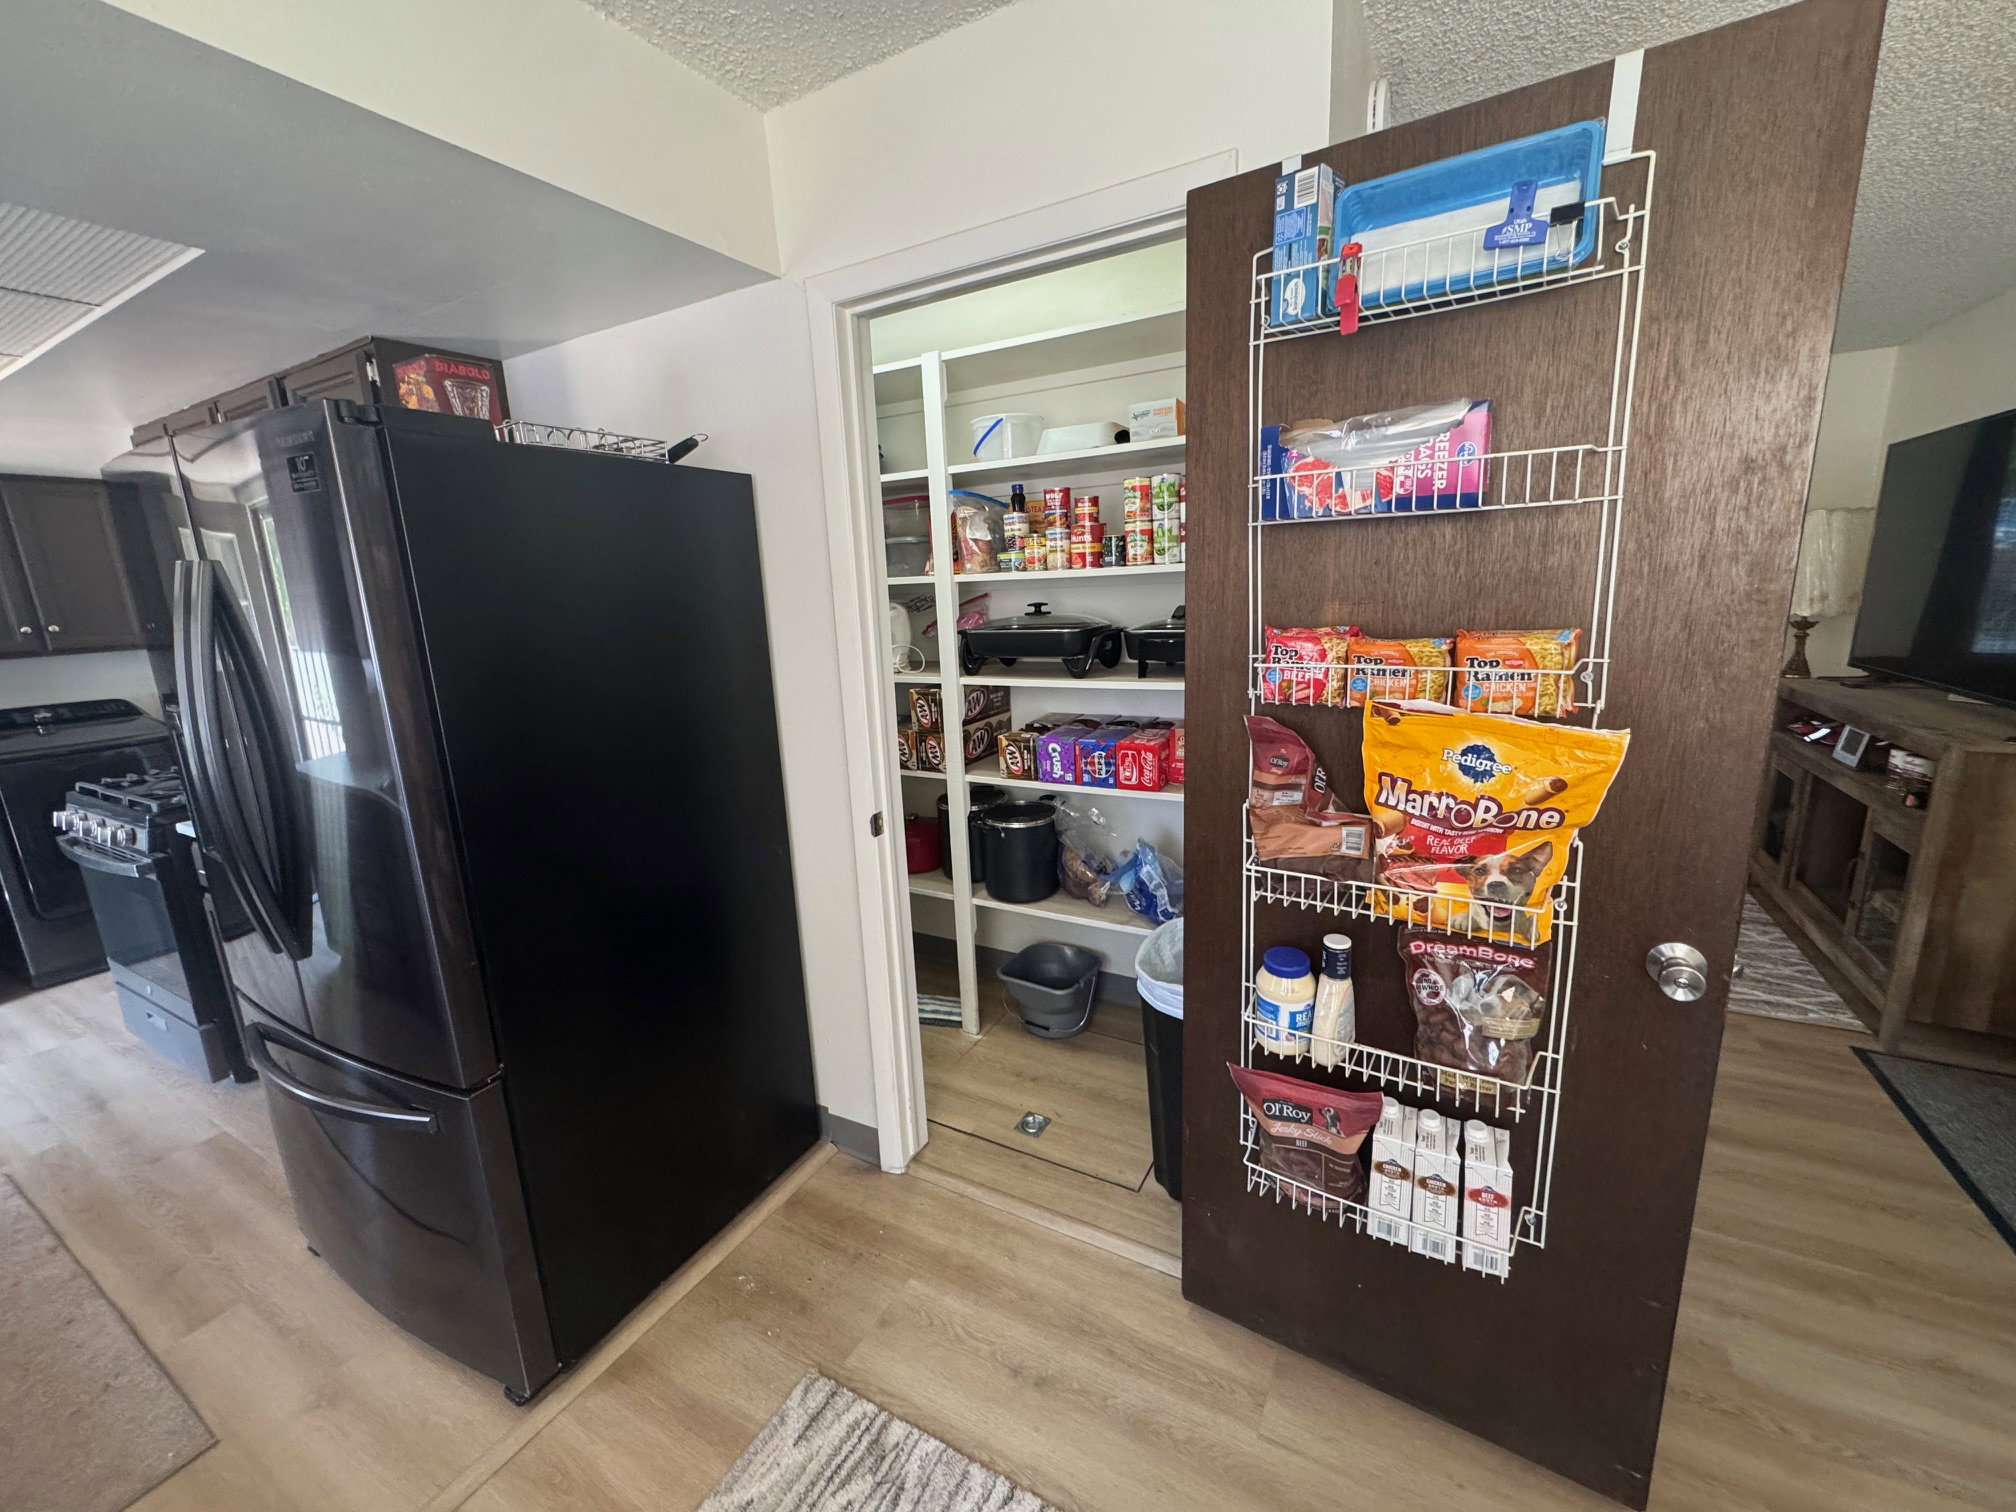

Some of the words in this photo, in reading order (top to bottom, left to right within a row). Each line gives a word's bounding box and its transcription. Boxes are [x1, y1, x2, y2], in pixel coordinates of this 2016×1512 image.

[434, 360, 491, 380] DIABOLO
[1433, 431, 1450, 490] REEZER
[1271, 644, 1299, 661] Top
[1353, 655, 1384, 666] Top
[1465, 657, 1501, 669] Top
[1048, 742, 1064, 778] Crush
[1441, 748, 1513, 775] Pedigree
[1378, 776, 1562, 830] MarroBone
[1426, 834, 1450, 847] REAL
[1430, 843, 1469, 855] FLAVOR
[1409, 940, 1536, 969] DreamBone
[1270, 1122, 1301, 1137] Jerky
[1481, 1192, 1495, 1200] BEEF
